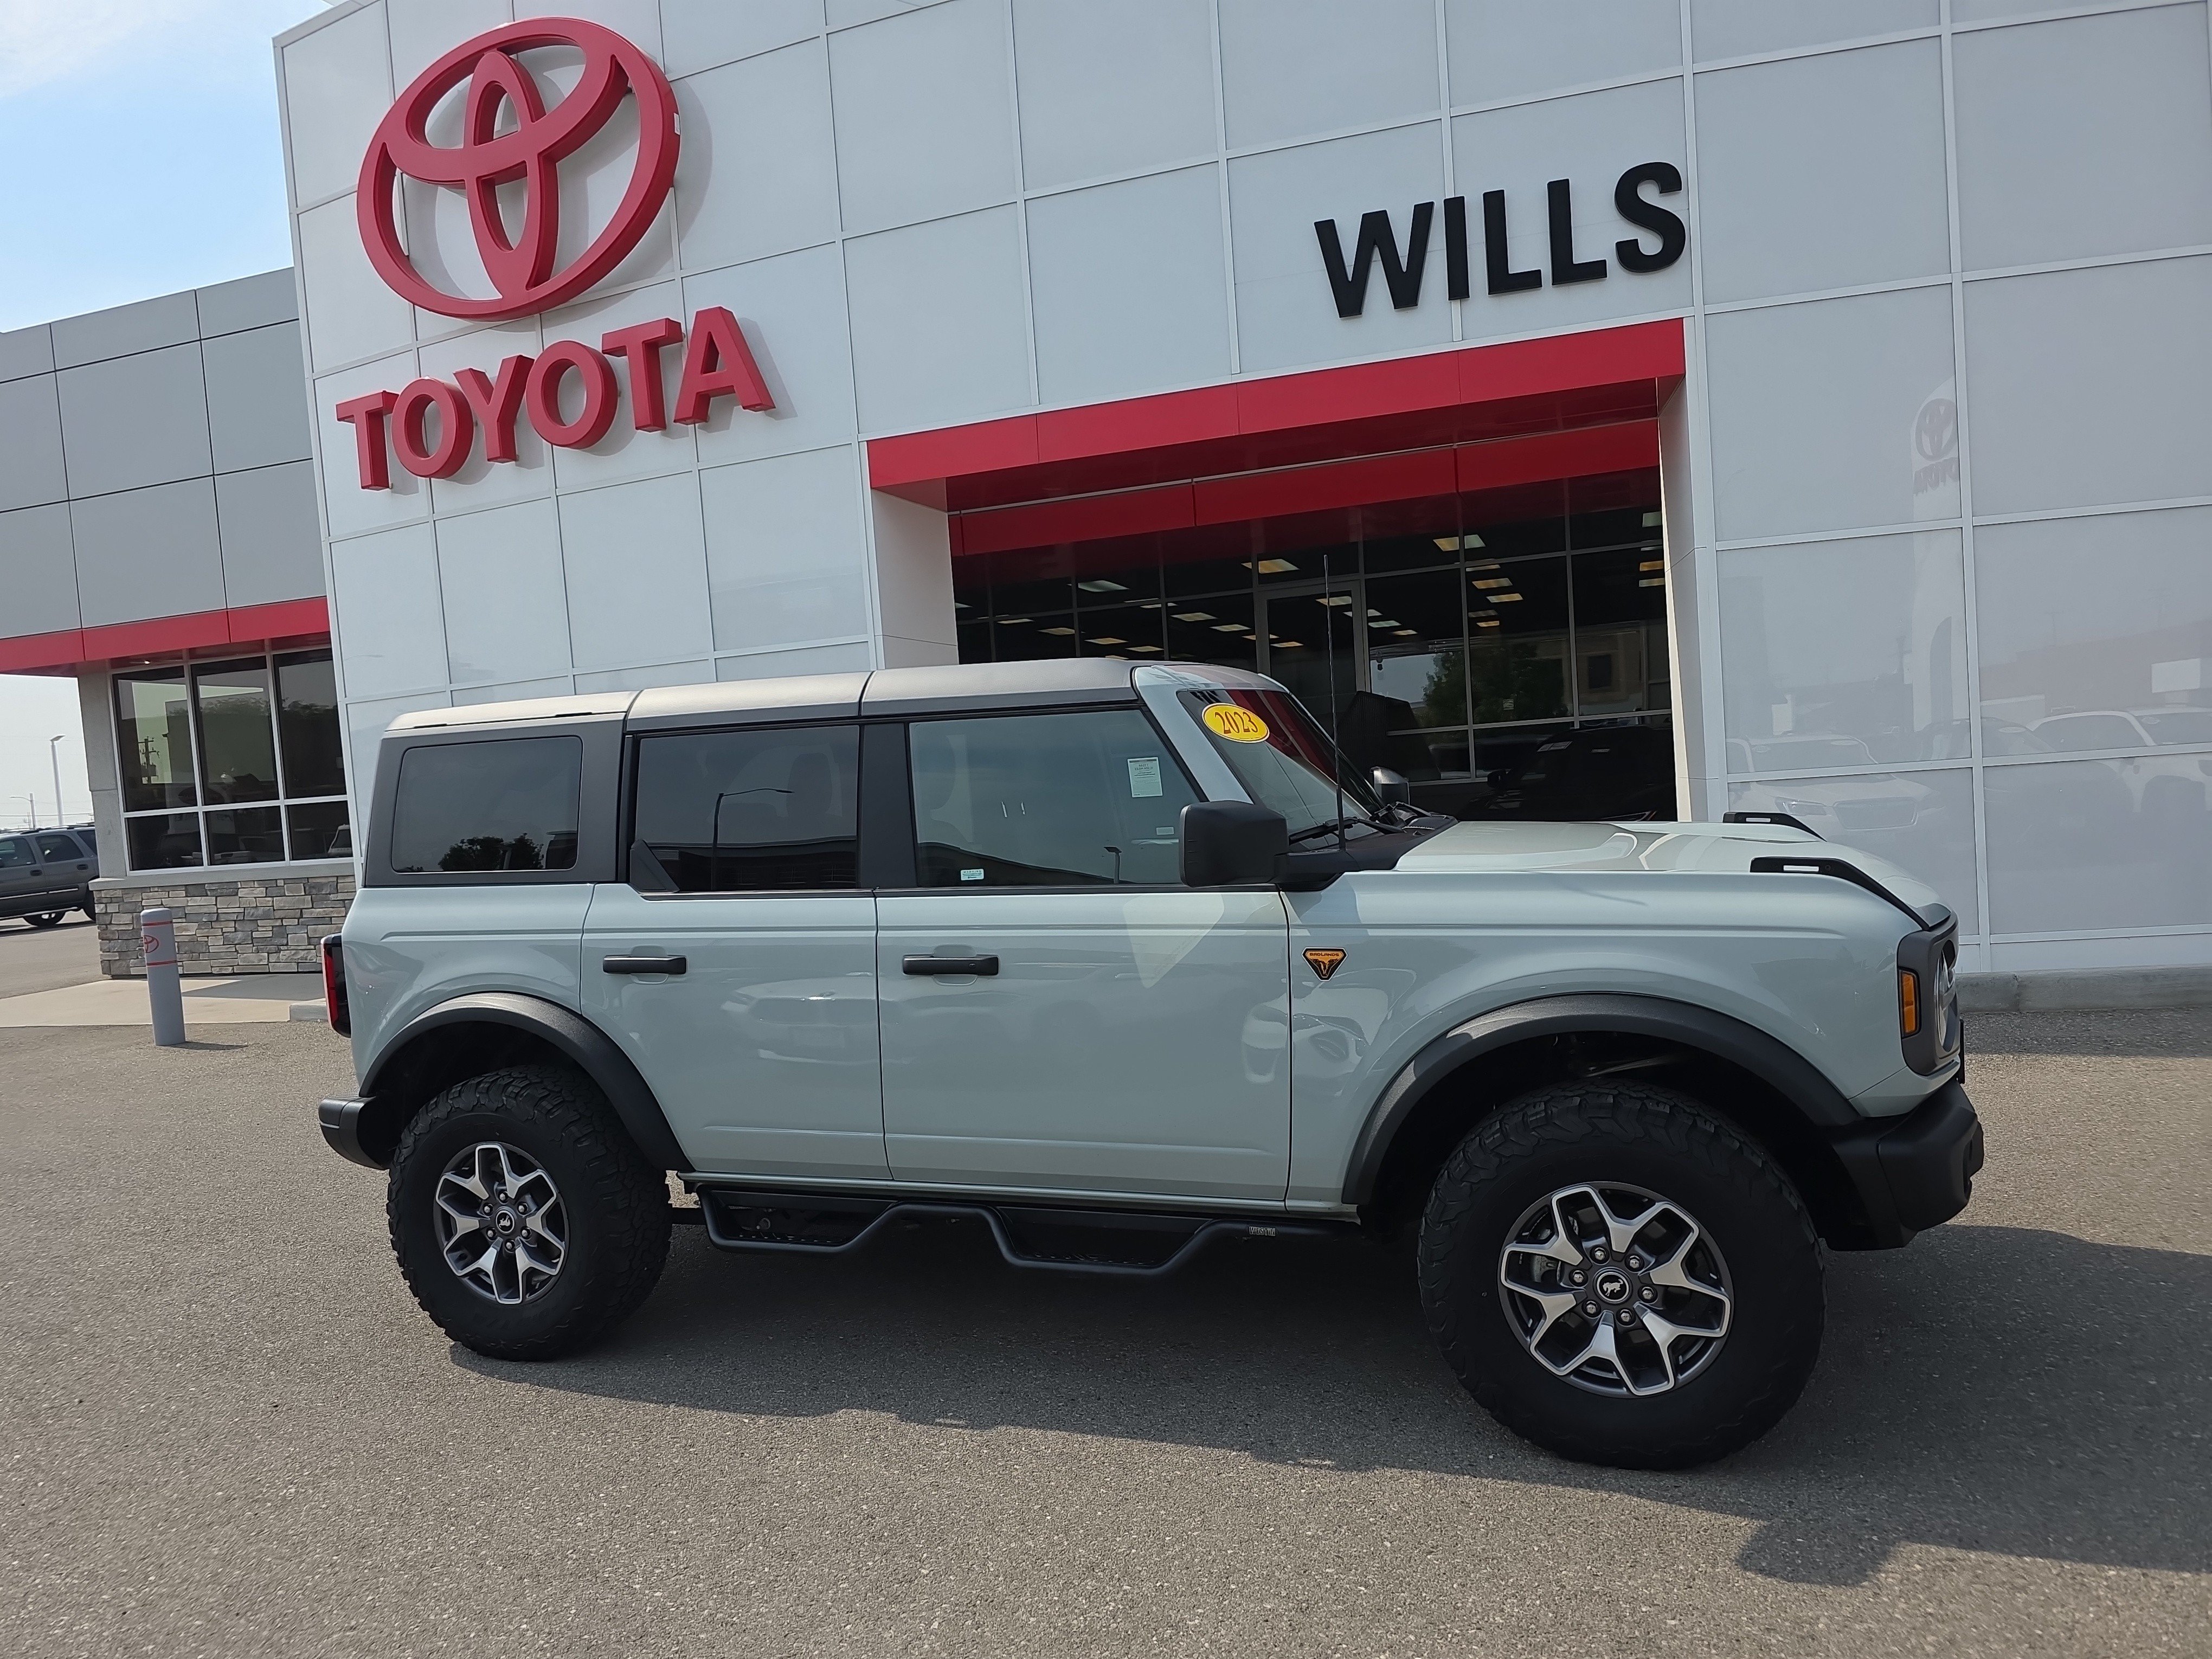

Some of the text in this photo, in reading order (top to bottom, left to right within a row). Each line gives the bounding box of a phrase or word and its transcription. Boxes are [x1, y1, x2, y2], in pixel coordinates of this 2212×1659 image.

[1314, 162, 1686, 319] WILLS
[336, 306, 776, 491] TOYOTA
[1214, 711, 1259, 735] 2023
[1249, 1226, 1276, 1237] WESTIN
